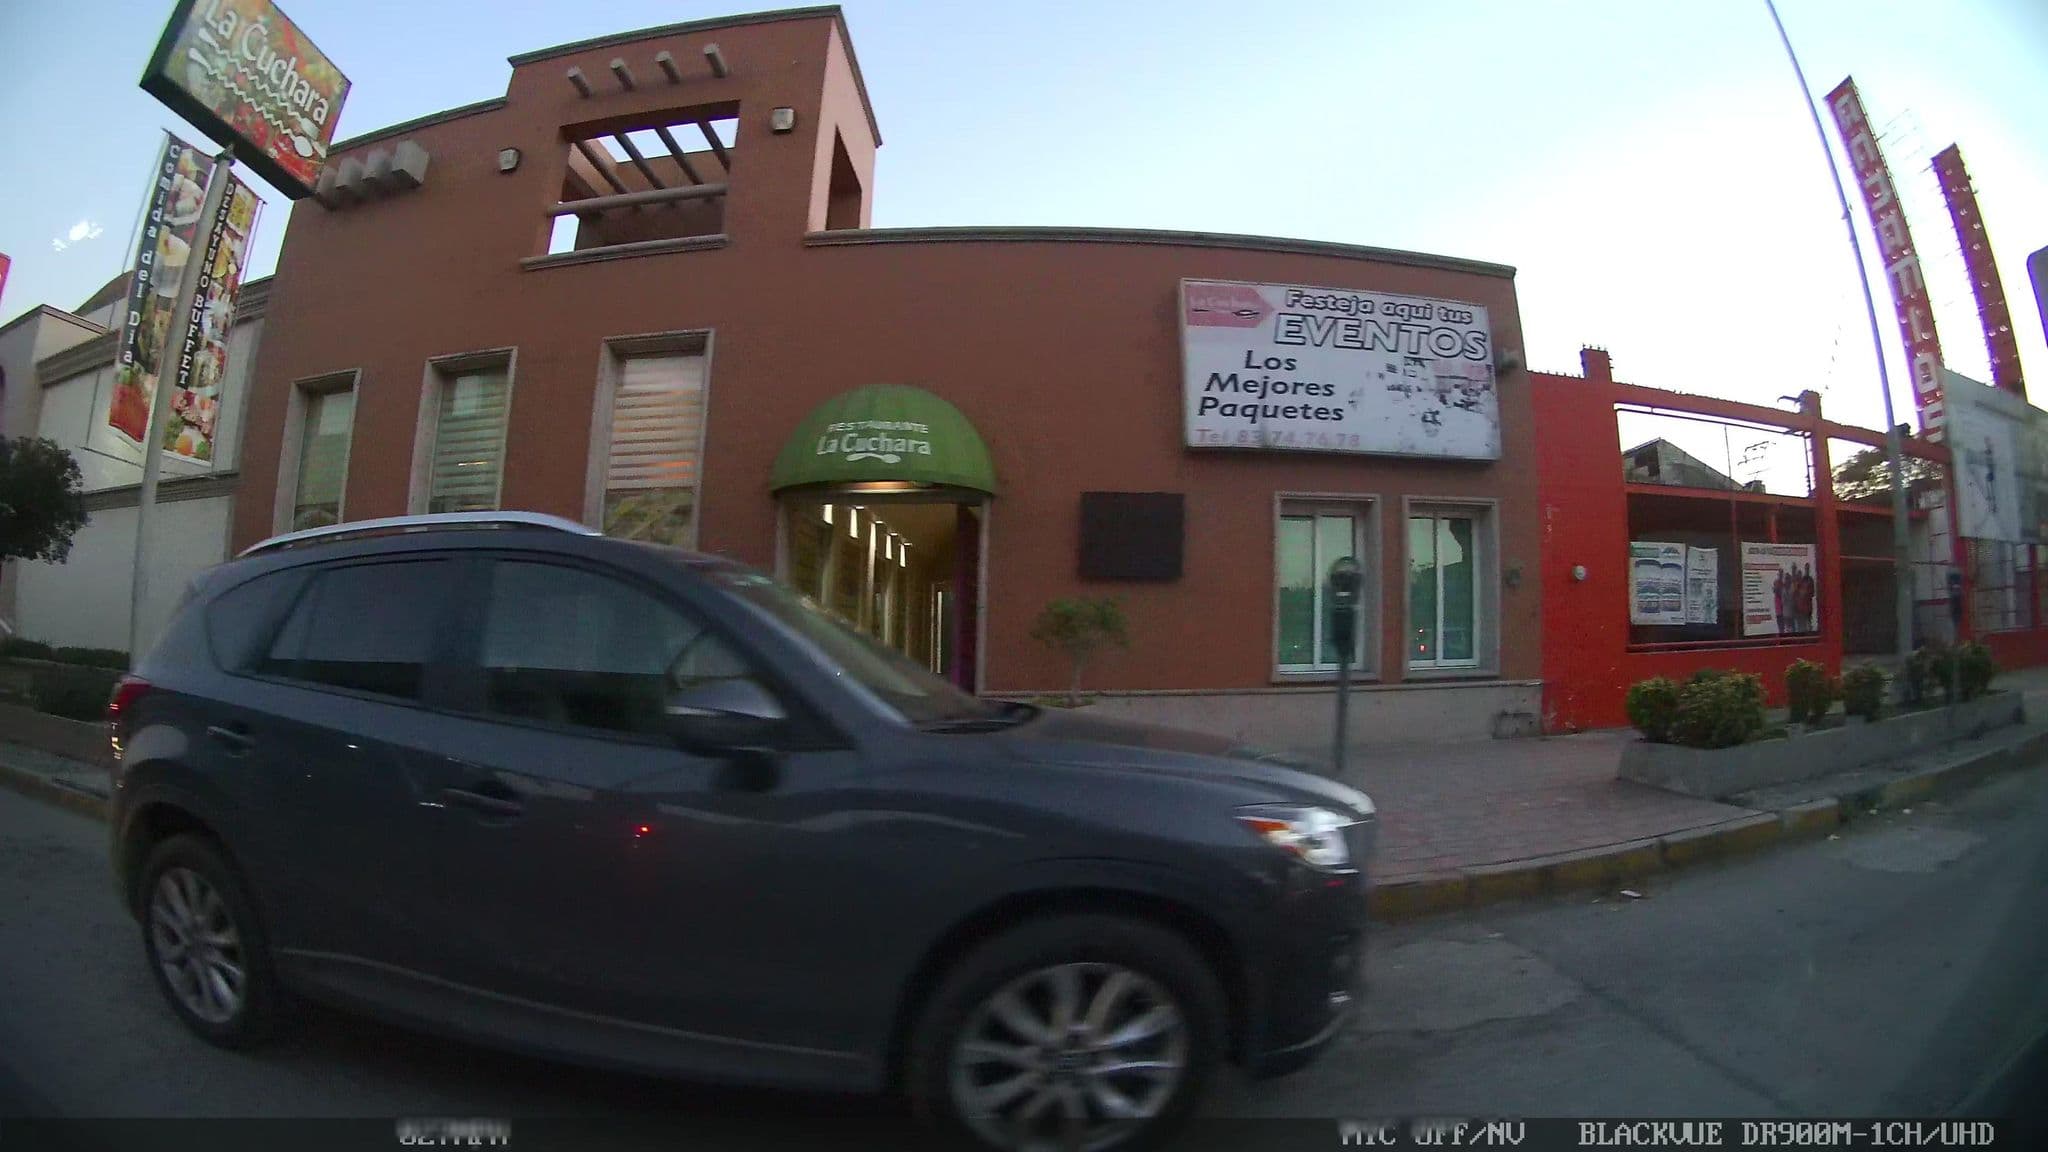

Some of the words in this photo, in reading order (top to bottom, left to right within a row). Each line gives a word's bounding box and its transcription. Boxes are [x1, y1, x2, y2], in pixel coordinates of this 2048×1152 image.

[205, 0, 237, 39] La
[242, 23, 328, 125] Cuchara
[200, 183, 235, 287] DESAYUNO
[1286, 289, 1375, 316] Festeja
[1438, 306, 1473, 325] tus
[1274, 313, 1488, 362] EVENTOS
[1244, 350, 1297, 371] Los
[1203, 372, 1335, 400] Mejores
[1197, 396, 1344, 424] Paquetes
[840, 432, 931, 455] Cuchara
